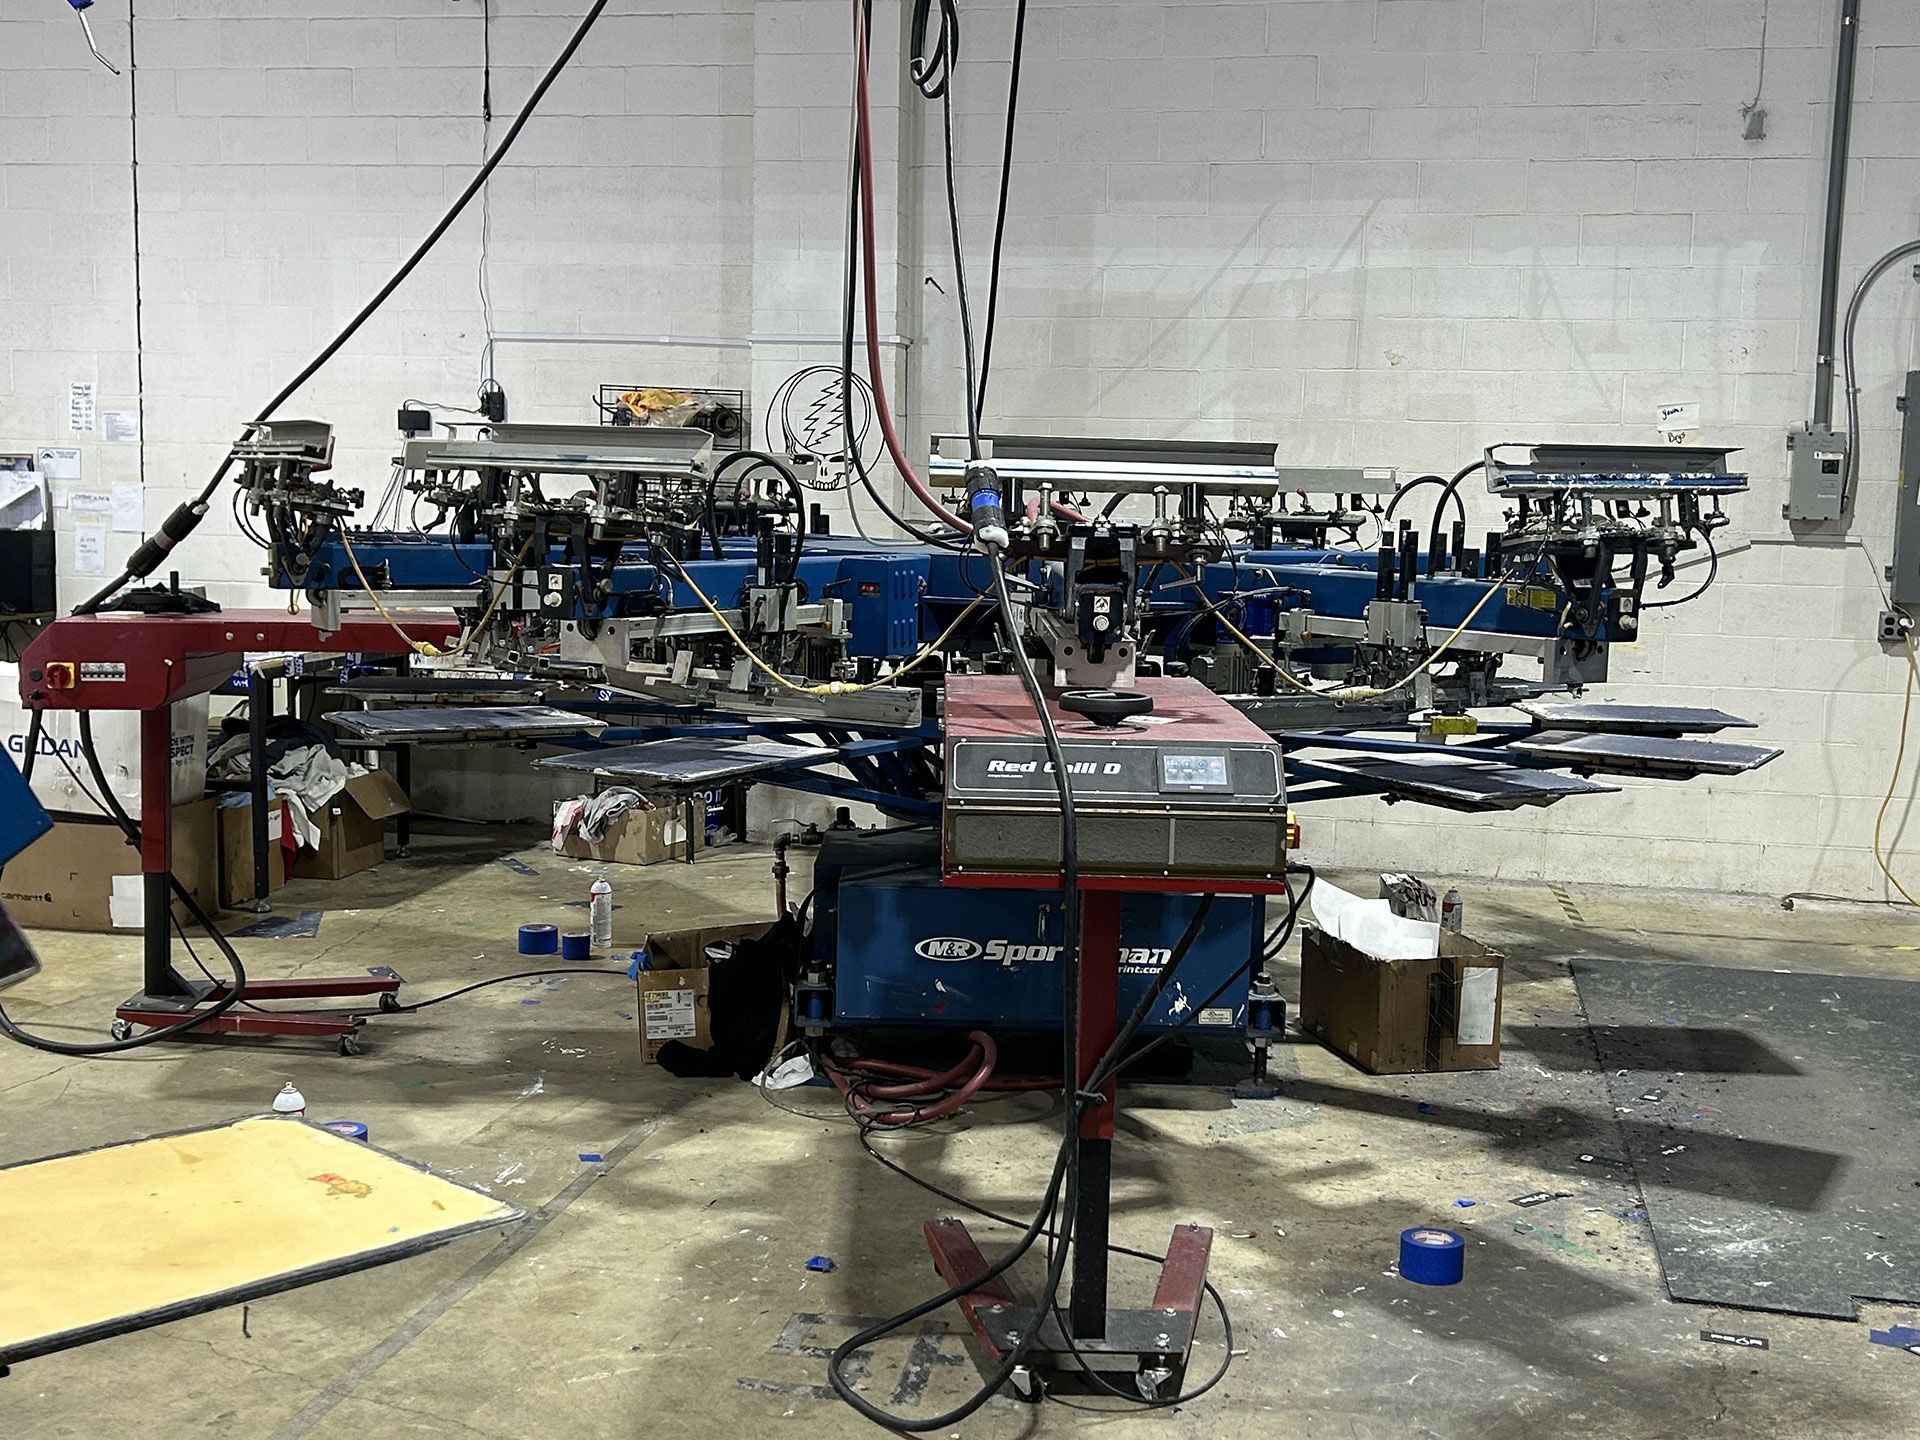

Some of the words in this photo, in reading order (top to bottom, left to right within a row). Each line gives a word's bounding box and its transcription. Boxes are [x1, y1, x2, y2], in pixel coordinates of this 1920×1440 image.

[987, 760, 1038, 773] Red
[1103, 762, 1121, 774] D
[928, 941, 971, 957] M&R
